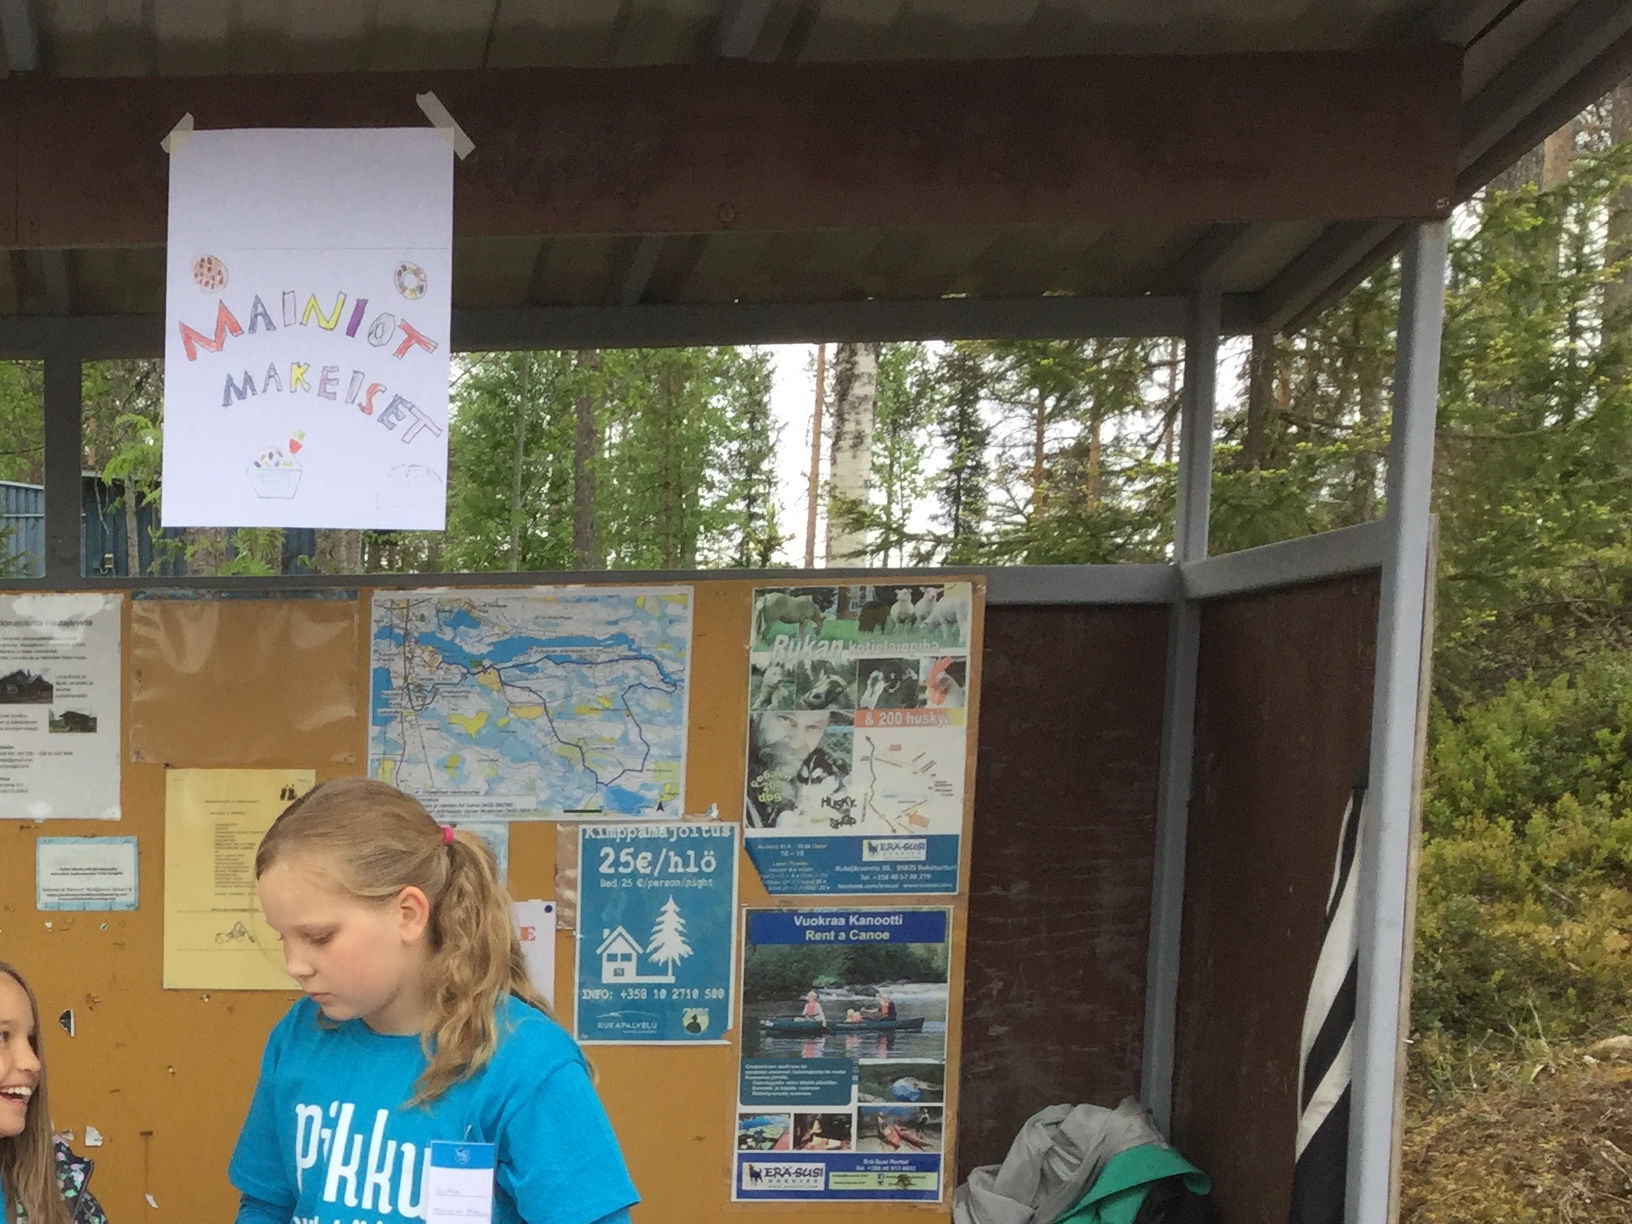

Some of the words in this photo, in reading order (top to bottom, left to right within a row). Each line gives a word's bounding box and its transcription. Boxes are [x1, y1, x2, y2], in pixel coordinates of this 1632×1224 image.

[179, 290, 439, 361] MAINIOT
[221, 361, 443, 444] MAKEISET
[770, 634, 843, 661] Rukan
[879, 711, 902, 725] 200
[585, 826, 731, 842] Kimppamajoitus
[598, 847, 717, 877] 25€/hlö
[600, 879, 617, 887] Bed
[621, 878, 633, 887] 25
[793, 915, 846, 927] Vuokraa
[849, 914, 903, 926] Kanootti
[805, 930, 836, 941] Rent
[838, 932, 846, 941] a
[849, 929, 891, 941] Canoe
[581, 989, 614, 1000] INFO:
[620, 988, 647, 1000] +358
[653, 989, 667, 999] 10
[672, 988, 699, 999] 2710
[295, 1101, 431, 1220] pikku
[763, 1166, 823, 1178] ERÄ-SUSI
